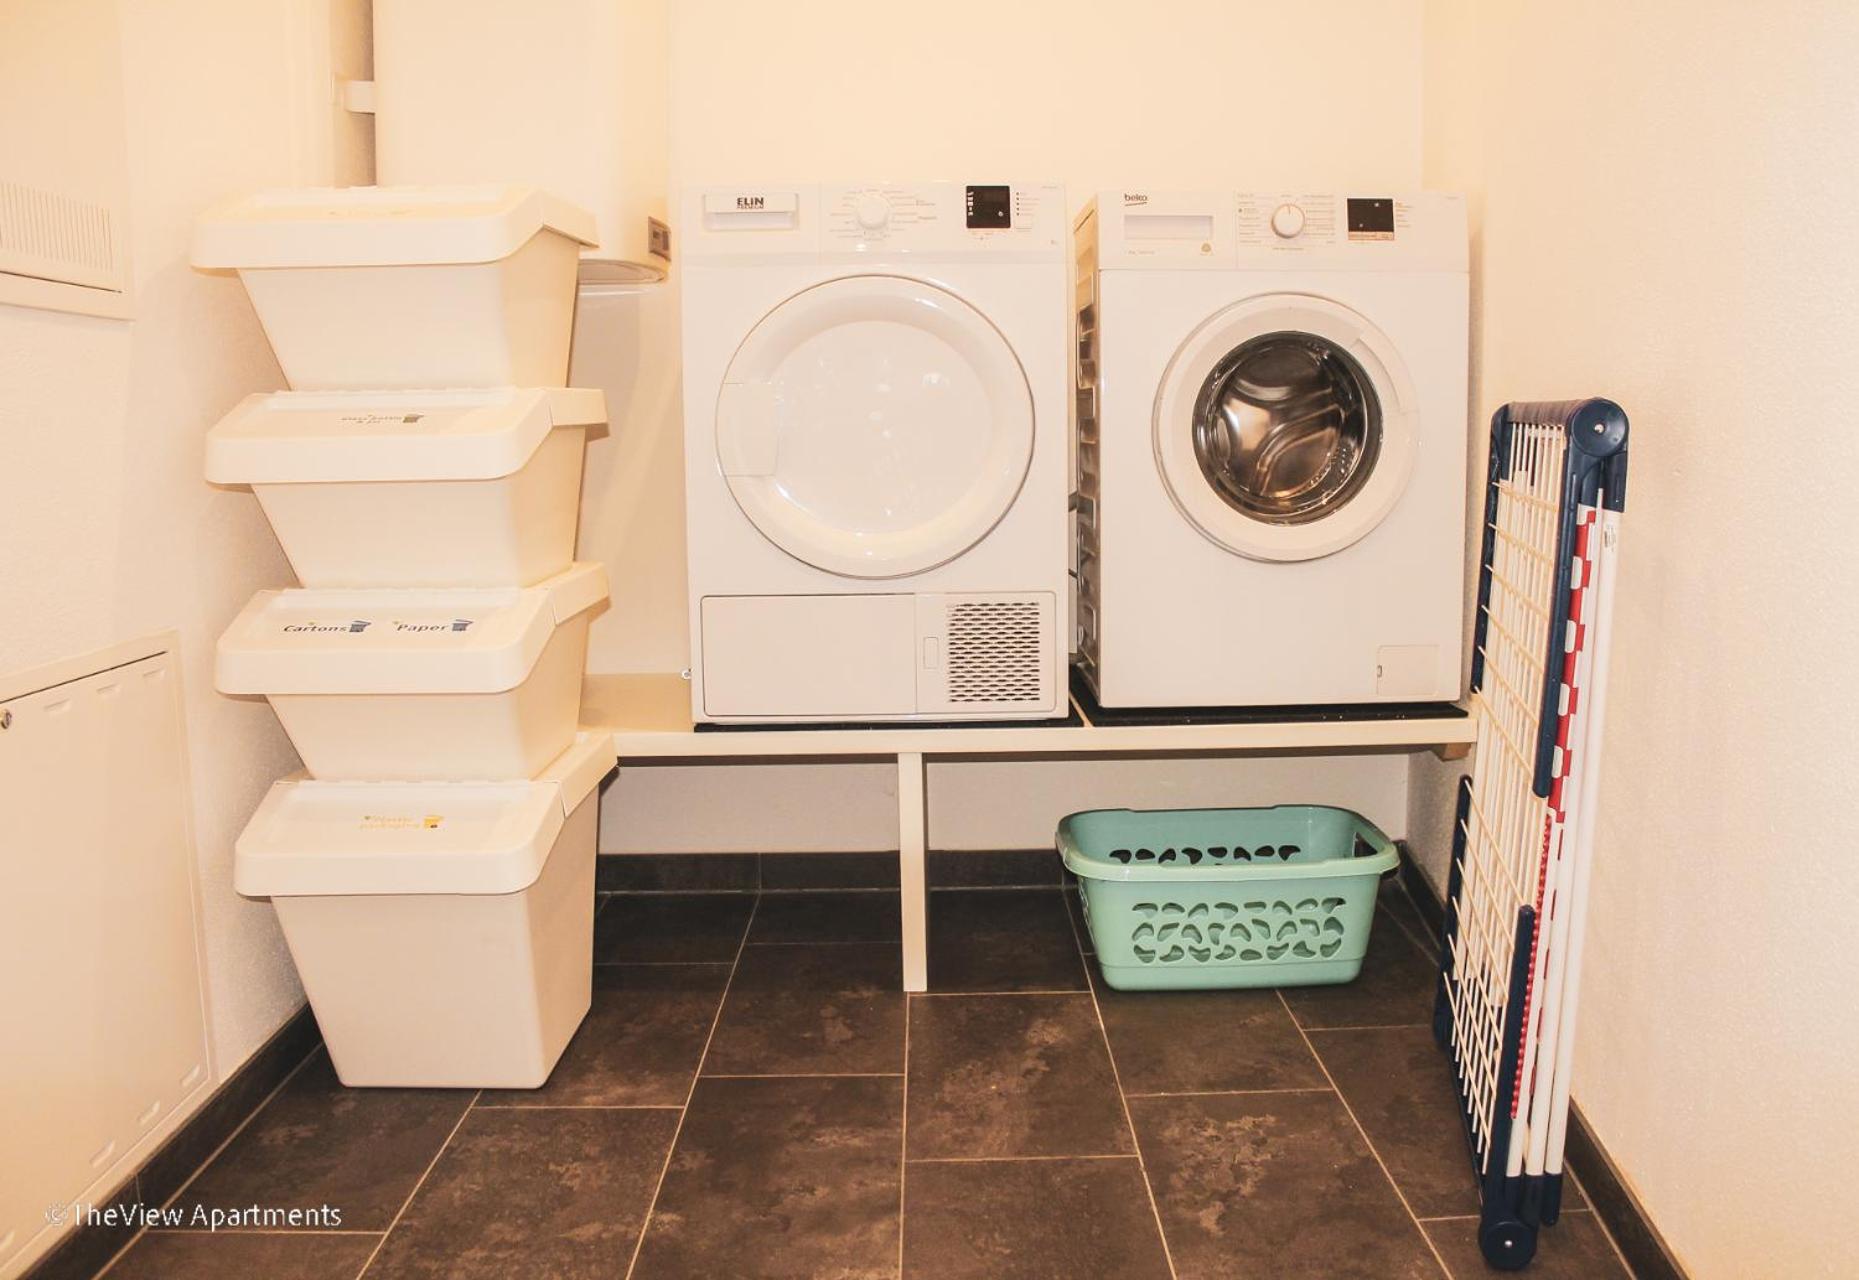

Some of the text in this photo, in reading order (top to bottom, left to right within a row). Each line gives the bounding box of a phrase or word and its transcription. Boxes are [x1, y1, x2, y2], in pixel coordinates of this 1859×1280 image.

[737, 197, 764, 205] ELIN
[1124, 193, 1148, 201] beko
[283, 623, 448, 633] Cartons Paper
